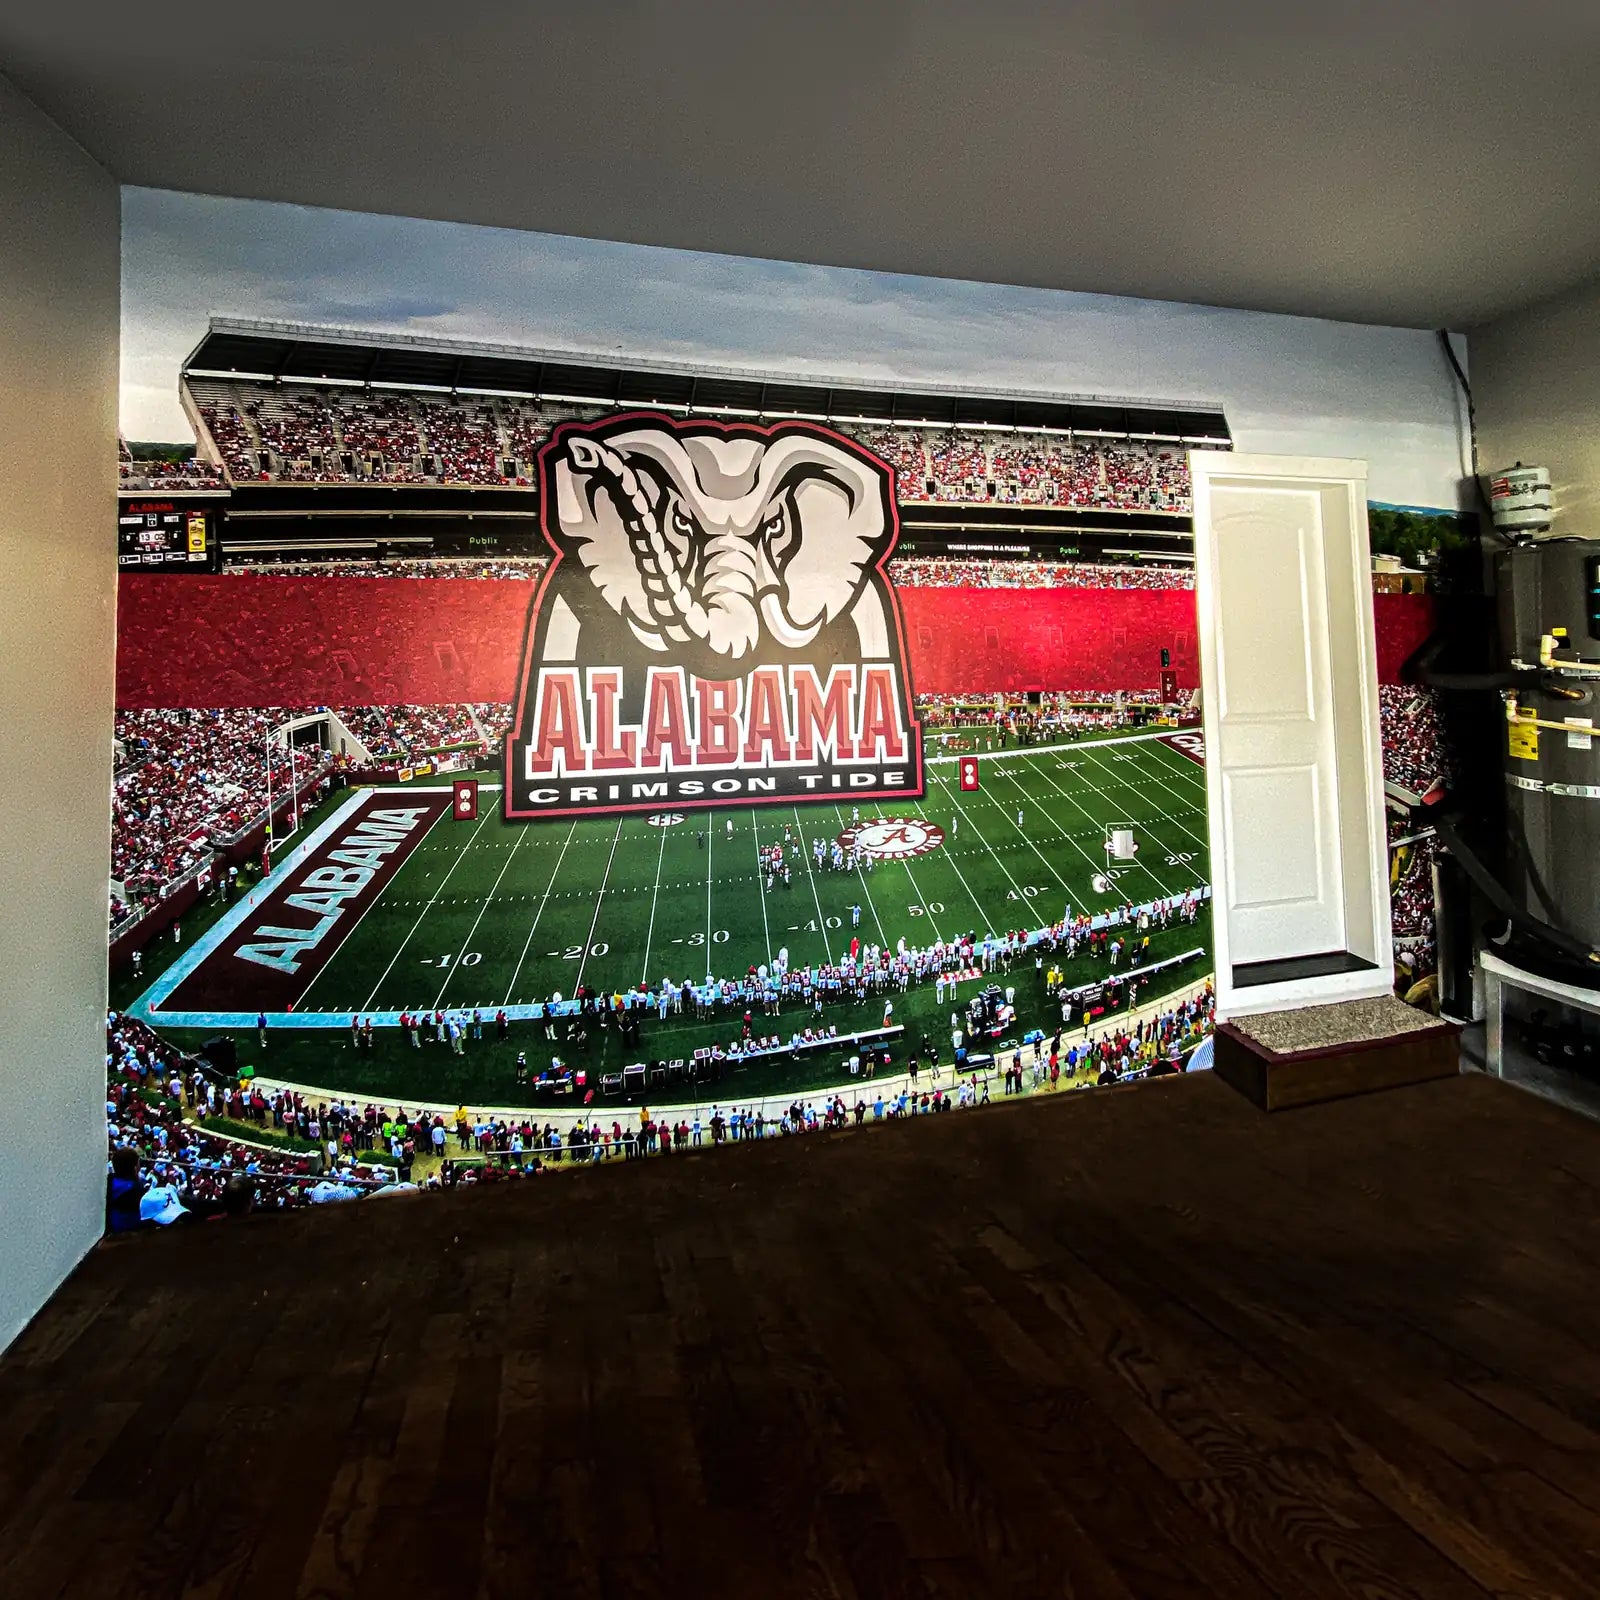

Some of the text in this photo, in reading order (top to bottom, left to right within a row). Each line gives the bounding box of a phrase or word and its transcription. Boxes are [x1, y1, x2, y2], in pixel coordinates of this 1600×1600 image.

[469, 536, 498, 545] Publix
[525, 664, 908, 779] ALABAMA
[528, 771, 906, 804] CRIMSON TIDE
[233, 806, 431, 976] ALABAMA
[908, 902, 945, 918] 50
